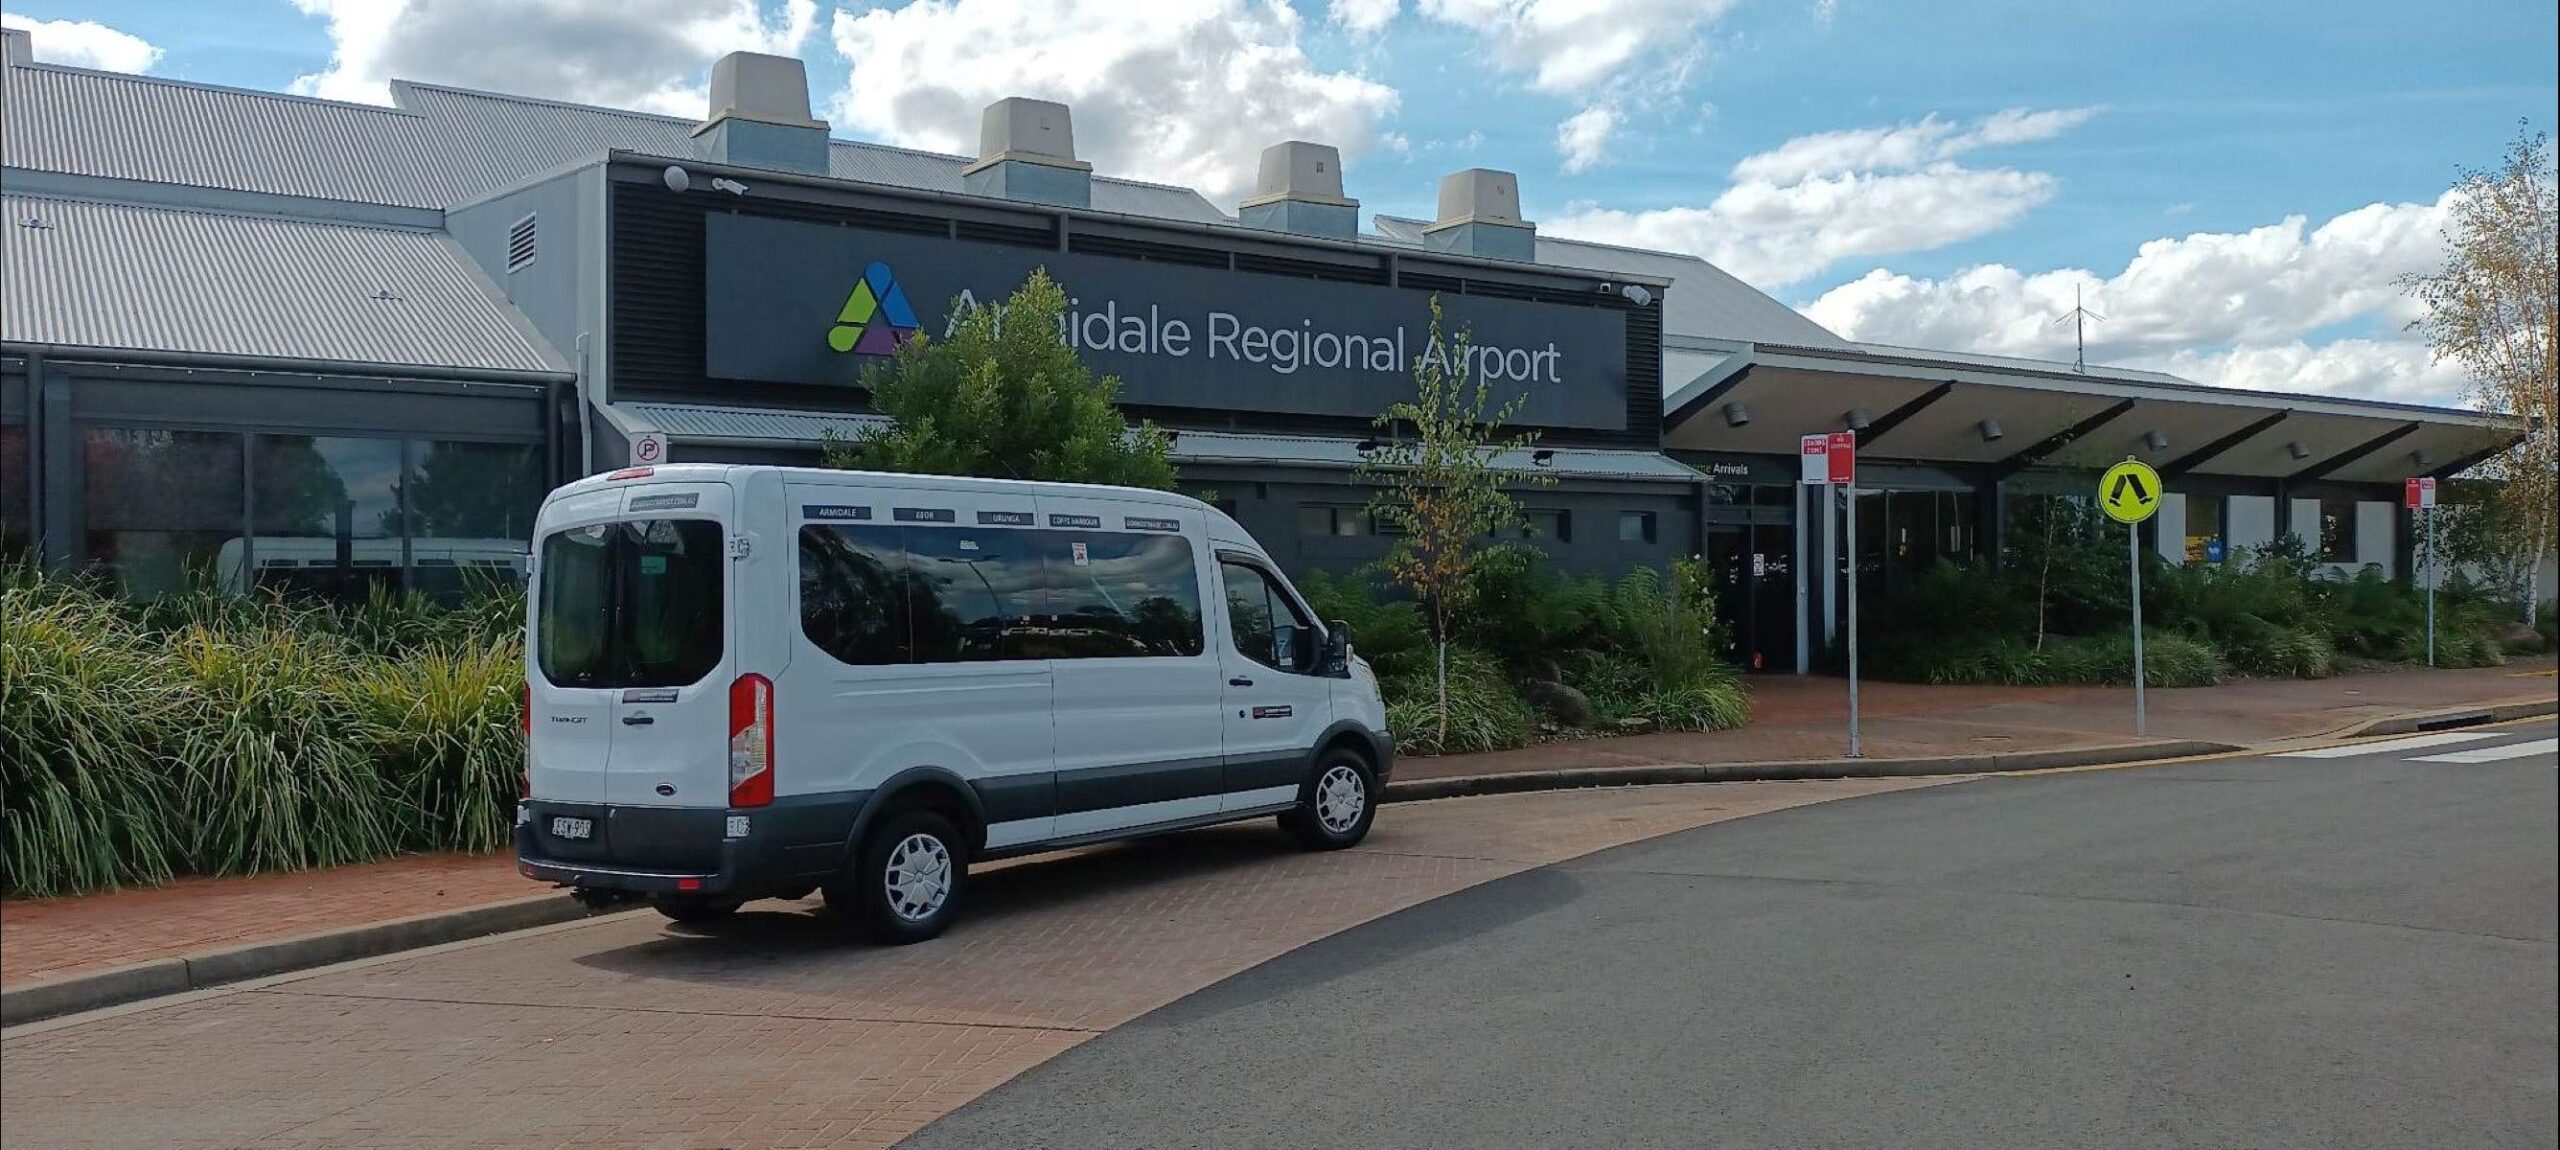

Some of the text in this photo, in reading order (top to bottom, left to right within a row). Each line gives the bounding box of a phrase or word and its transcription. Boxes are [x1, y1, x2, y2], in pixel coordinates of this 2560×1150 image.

[944, 289, 1561, 386] Aridale Regional Airport
[1713, 464, 1748, 475] Arrivals
[819, 508, 857, 517] ARMIDALE
